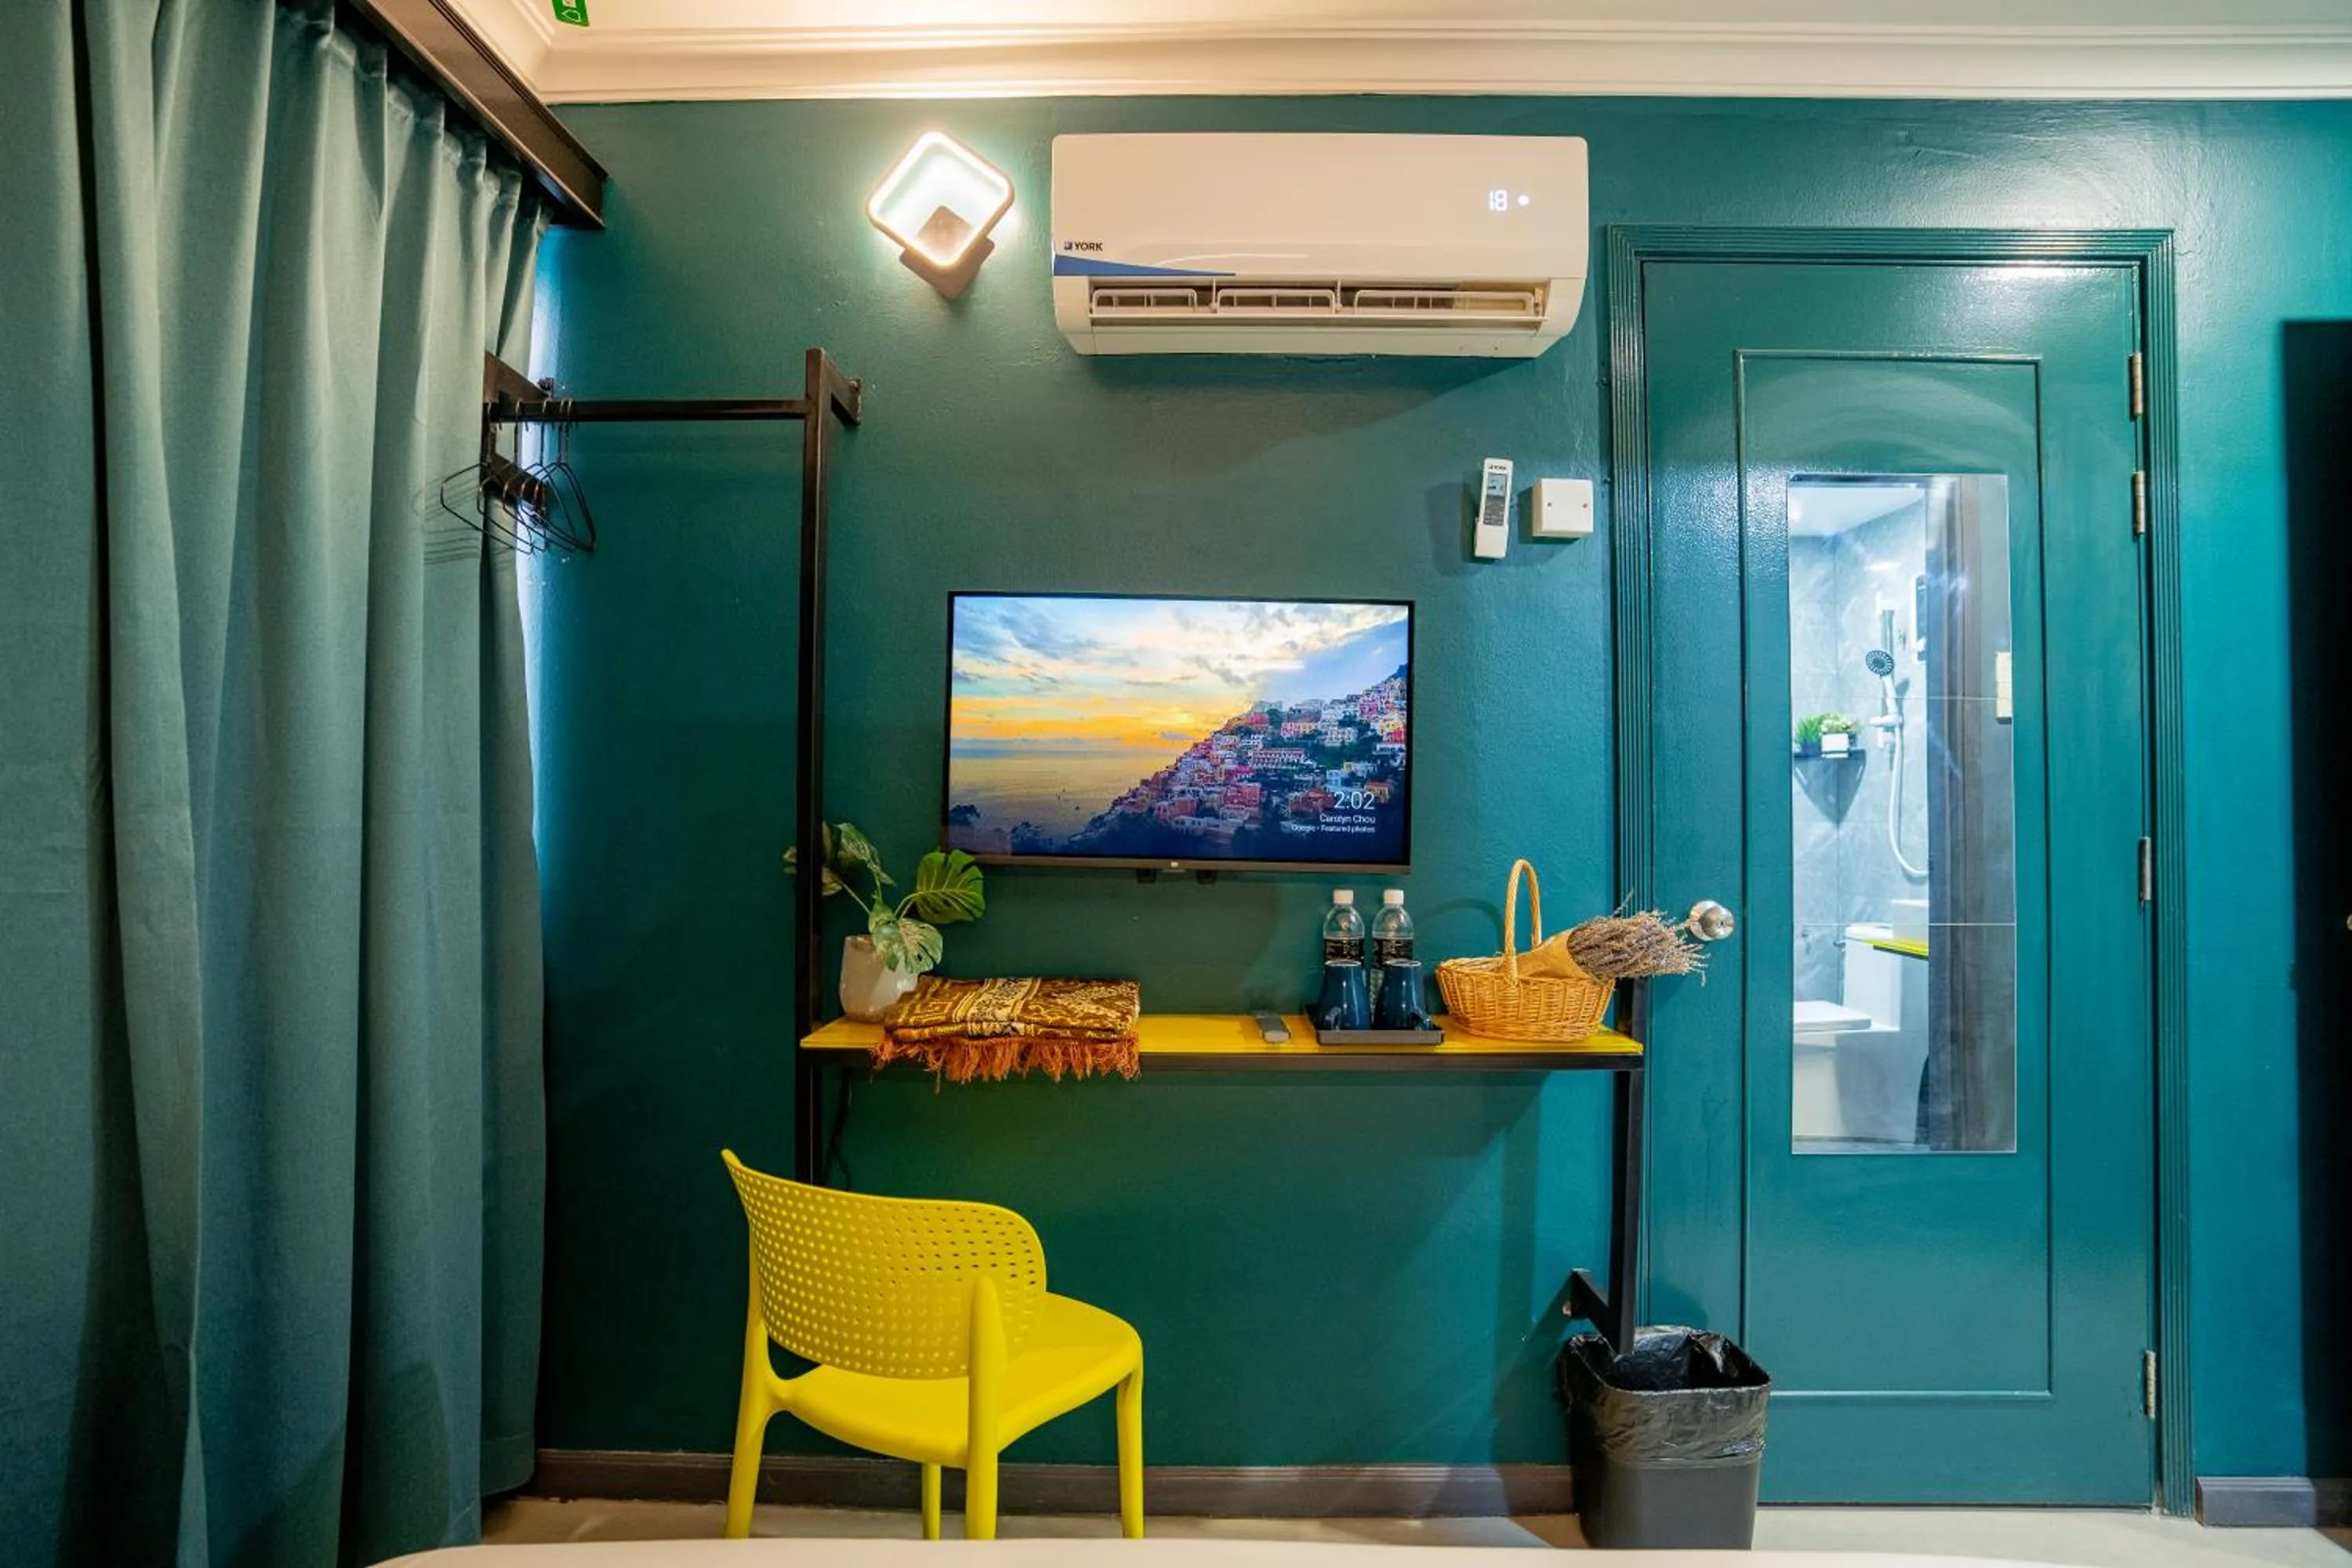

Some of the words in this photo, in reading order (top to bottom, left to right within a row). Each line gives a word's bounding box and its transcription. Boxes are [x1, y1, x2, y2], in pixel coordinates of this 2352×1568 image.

[1490, 190, 1507, 211] 18
[1075, 241, 1103, 251] YORK
[1334, 791, 1374, 809] 2:02
[1291, 824, 1316, 833] Google
[1351, 826, 1375, 834] photos
